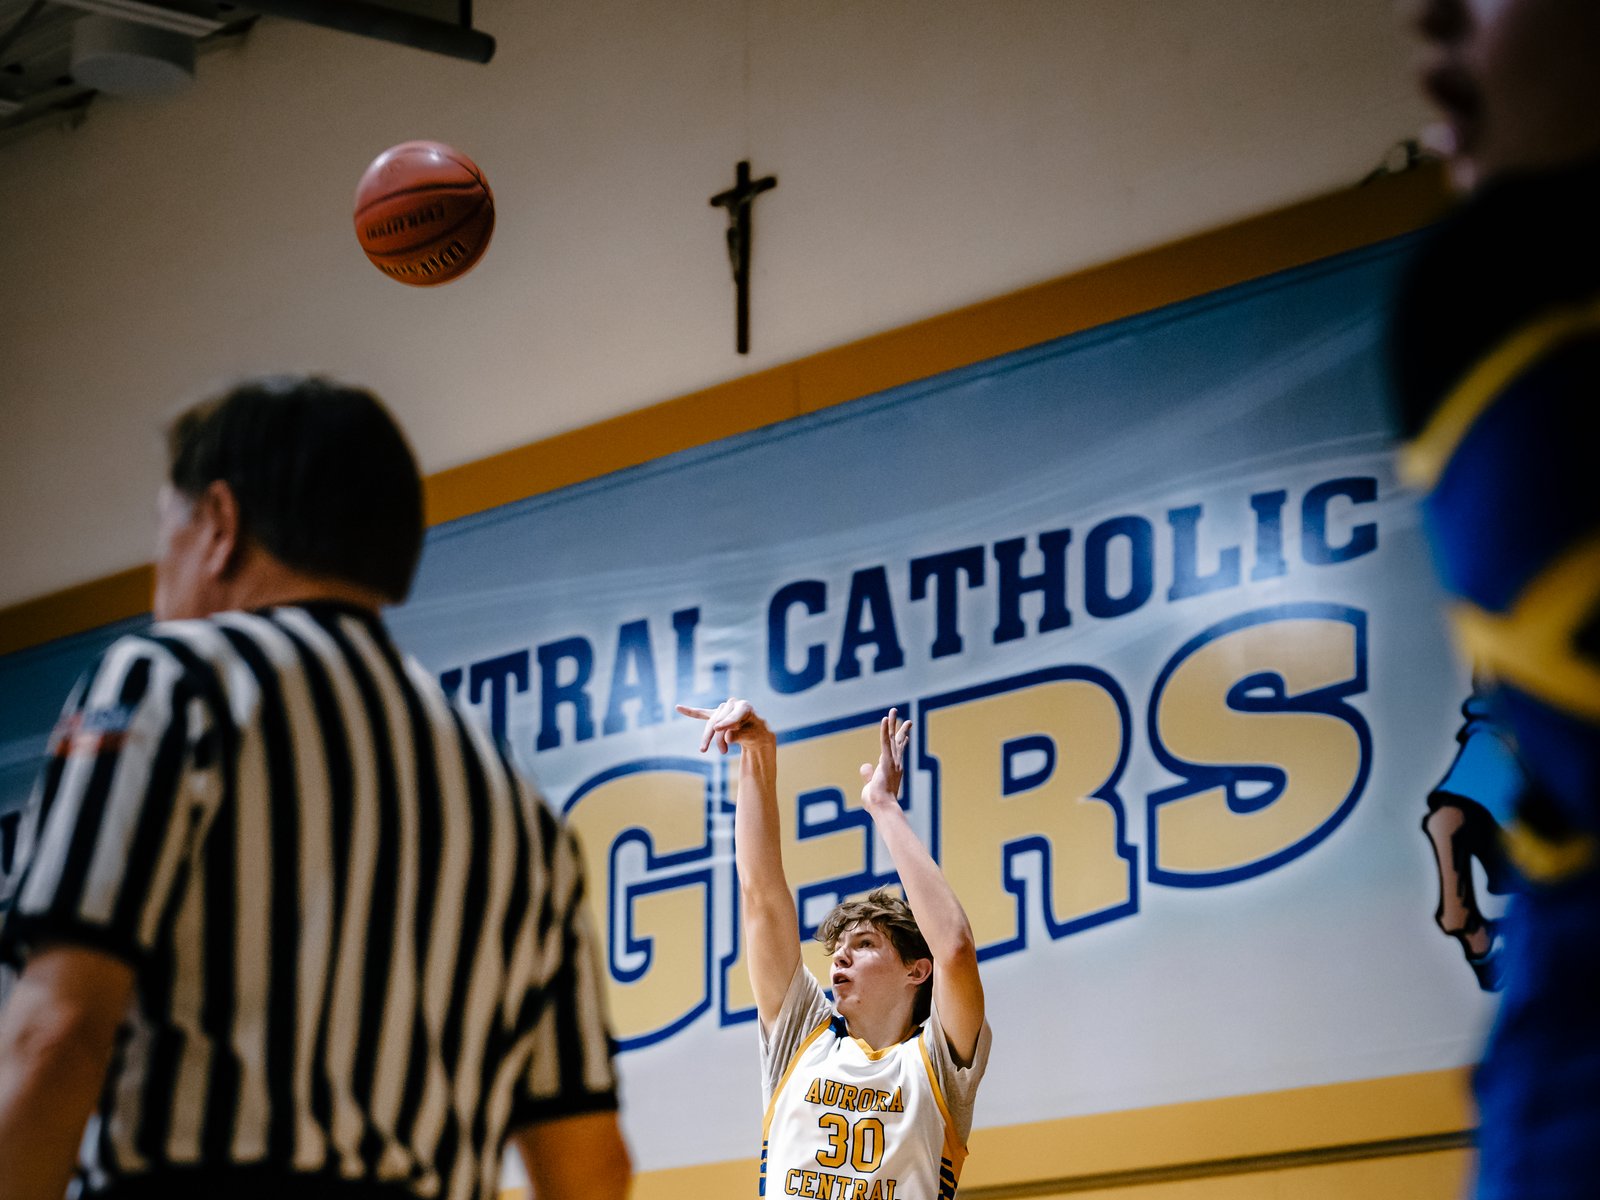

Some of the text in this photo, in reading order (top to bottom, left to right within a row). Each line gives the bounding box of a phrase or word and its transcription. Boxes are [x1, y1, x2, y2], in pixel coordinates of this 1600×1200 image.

[441, 475, 1379, 754] TRAL CATHOLIC
[804, 1077, 904, 1112] AURORA
[815, 1113, 885, 1173] 30
